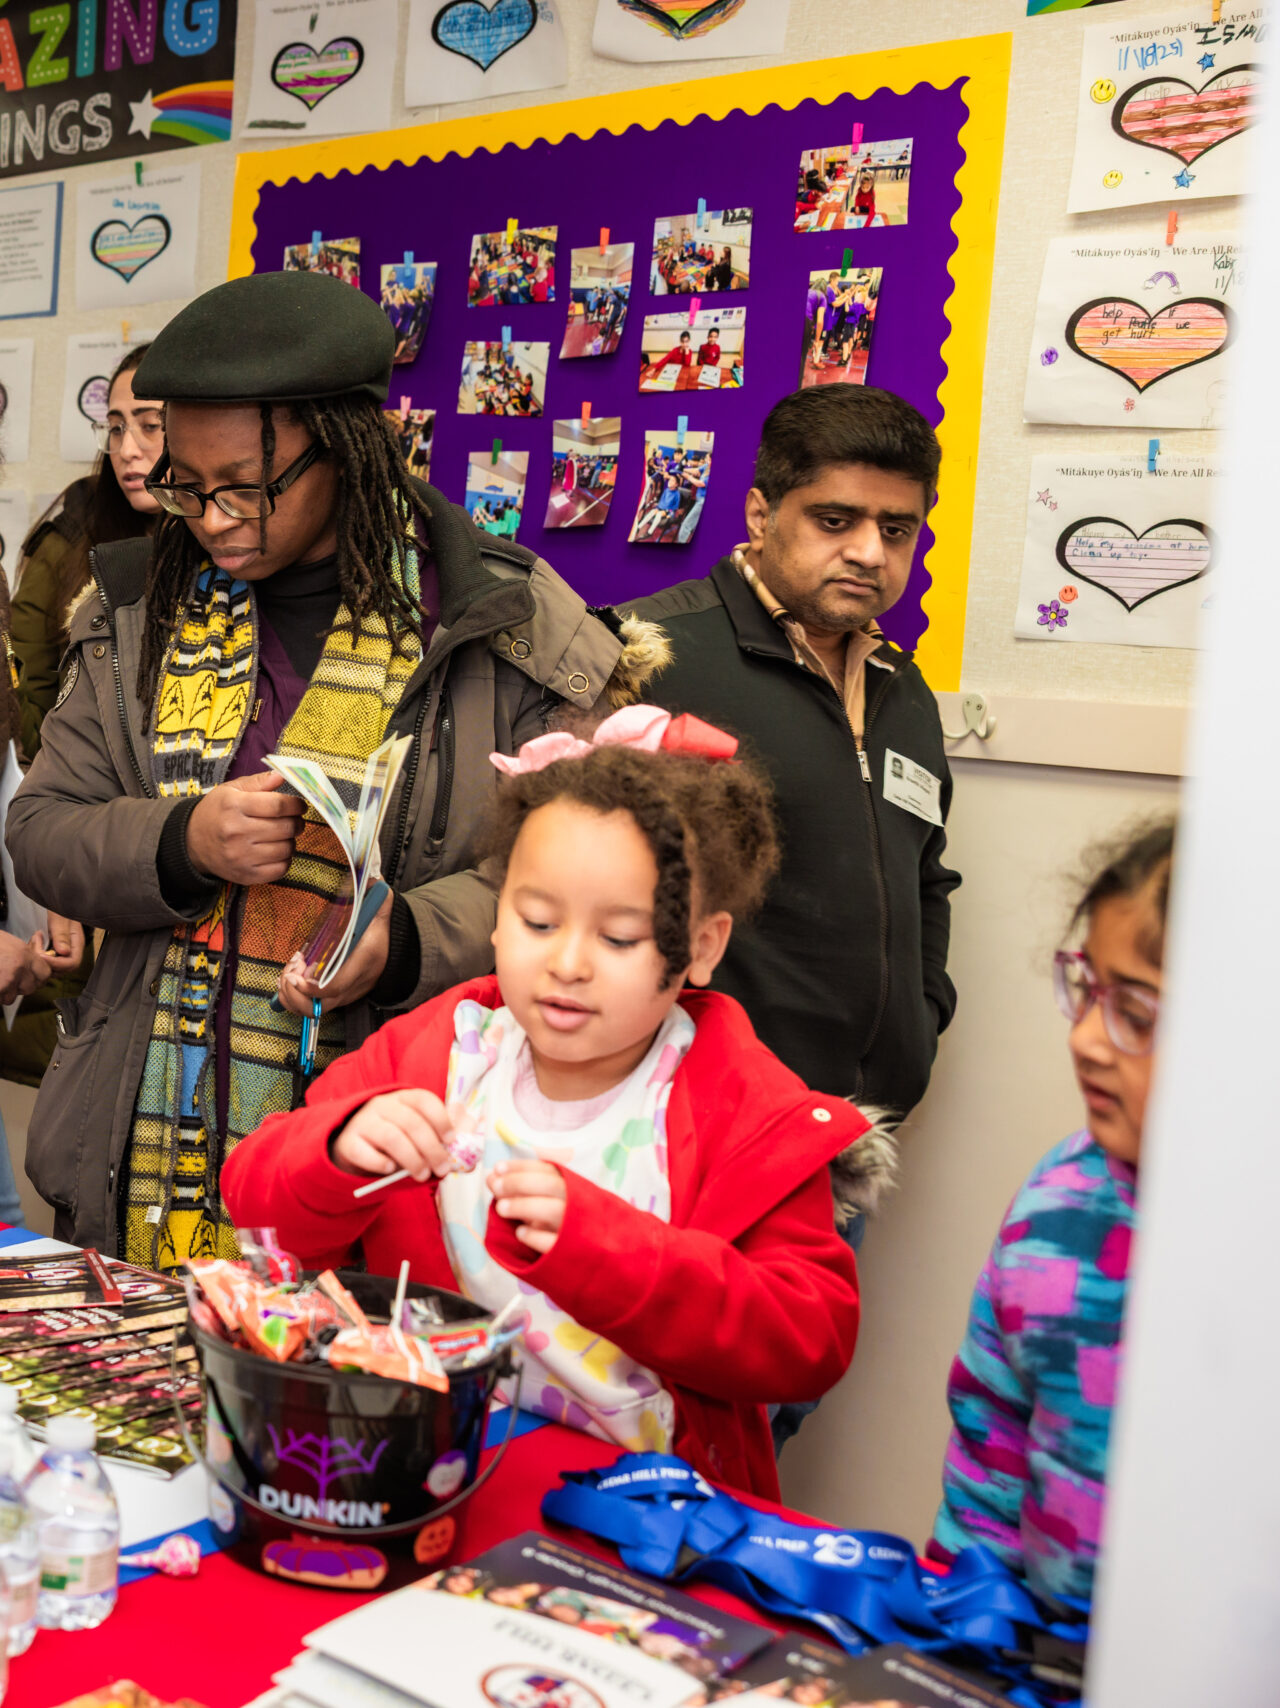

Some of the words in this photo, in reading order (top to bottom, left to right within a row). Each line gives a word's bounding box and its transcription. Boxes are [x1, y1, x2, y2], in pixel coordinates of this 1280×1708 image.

[1230, 14, 1246, 23] Are
[1172, 247, 1187, 256] We
[1191, 246, 1208, 255] Are
[1210, 245, 1225, 255] All
[1103, 303, 1123, 324] help
[1175, 321, 1190, 330] we
[1102, 328, 1121, 345] get
[1154, 468, 1171, 478] We
[1172, 468, 1188, 478] Are
[1190, 468, 1204, 478] All
[596, 1473, 632, 1492] CEDAR
[631, 1468, 659, 1482] HILL
[660, 1467, 690, 1481] PREP
[258, 1483, 391, 1527] DUNKIN'
[774, 1537, 810, 1554] PREP
